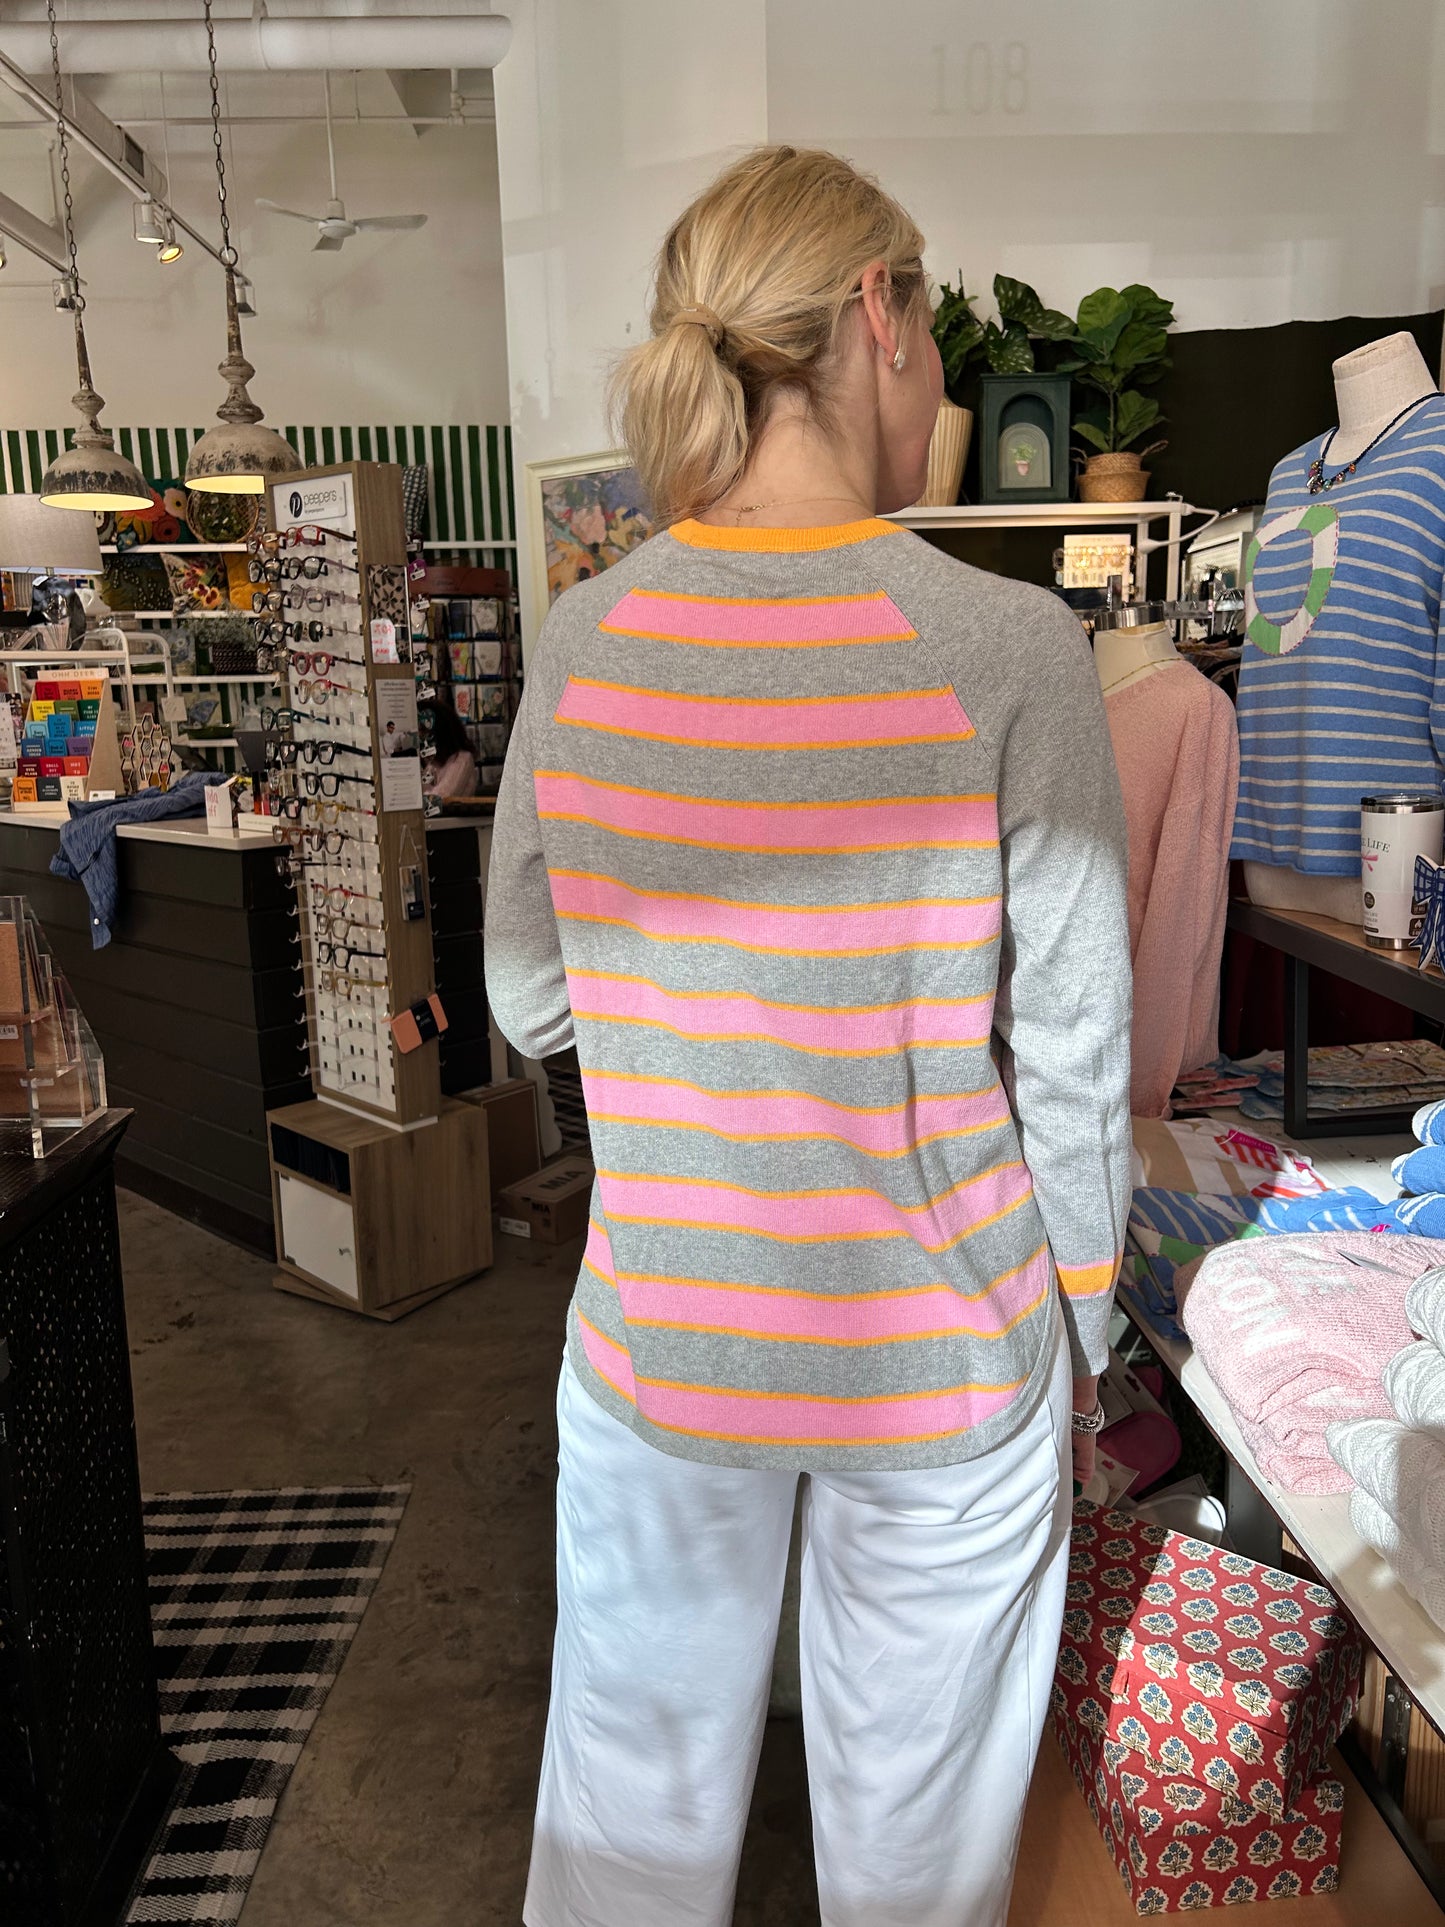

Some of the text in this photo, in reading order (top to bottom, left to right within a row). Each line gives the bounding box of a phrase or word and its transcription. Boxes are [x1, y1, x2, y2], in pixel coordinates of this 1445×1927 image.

[928, 40, 1032, 116] 108
[303, 489, 338, 506] peepers
[73, 670, 95, 678] DEER
[1367, 836, 1391, 853] LIFE
[538, 1170, 587, 1190] MIA
[531, 1202, 551, 1214] MIA
